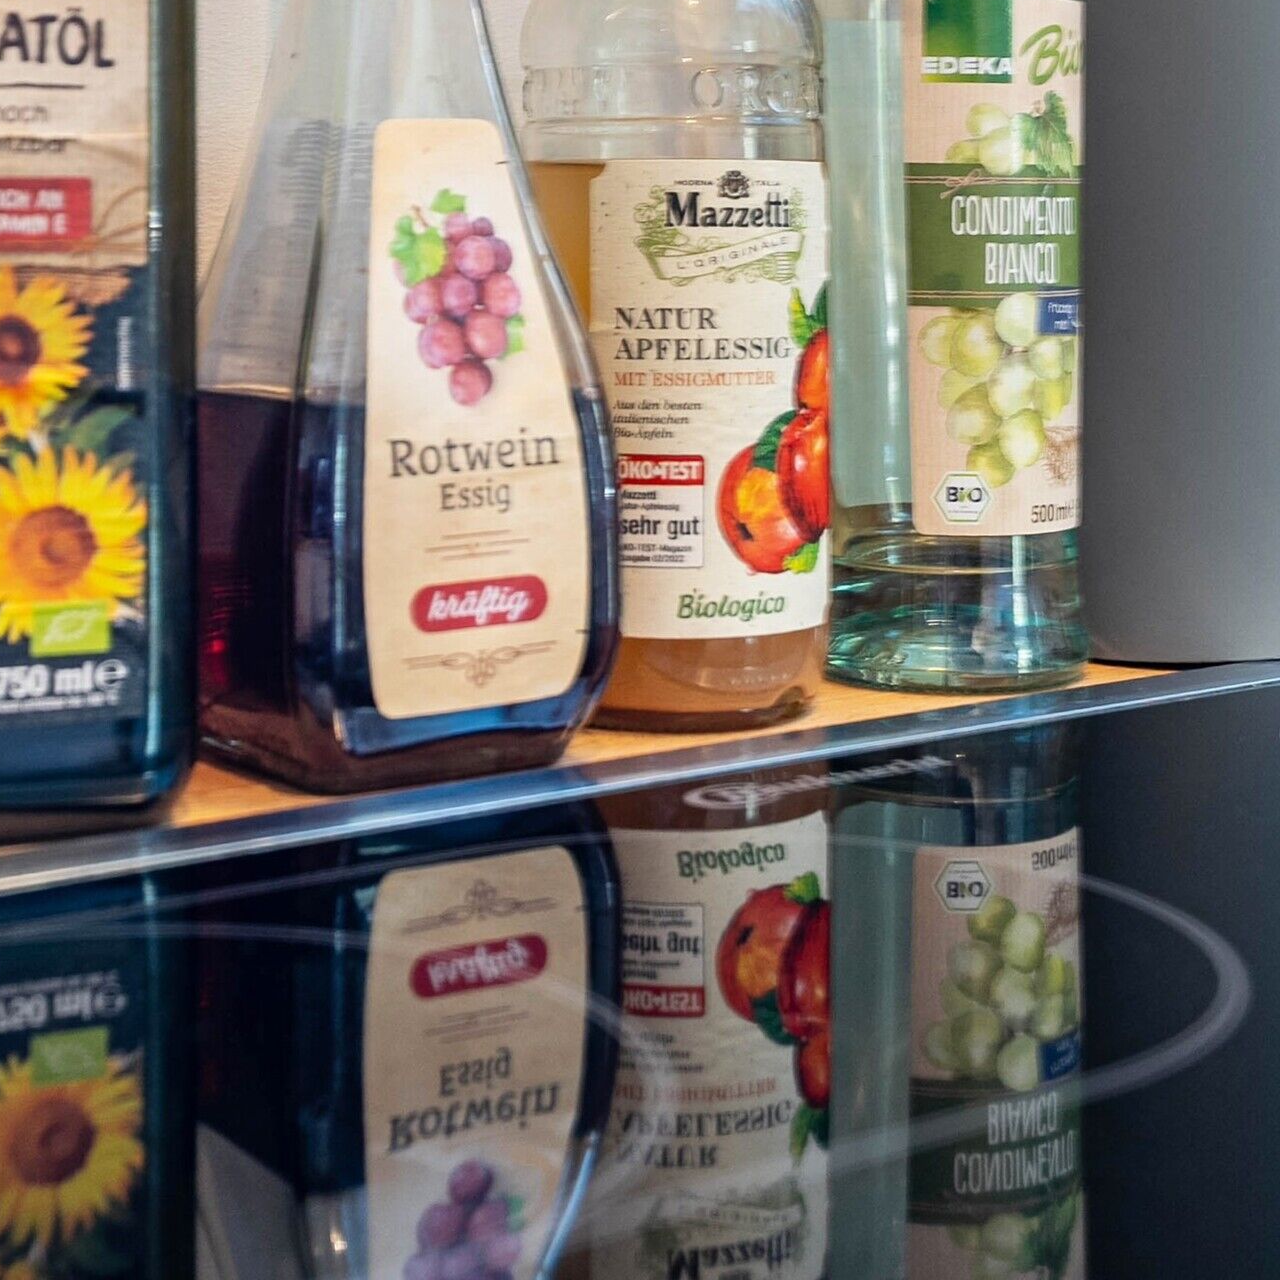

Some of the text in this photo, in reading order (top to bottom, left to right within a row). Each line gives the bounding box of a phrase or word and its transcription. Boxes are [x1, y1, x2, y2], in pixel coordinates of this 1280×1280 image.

[920, 56, 1013, 76] EDEKA
[663, 191, 790, 228] Mazzetti
[950, 196, 1077, 237] CONDIMENTO
[984, 243, 1060, 285] BIANCO
[613, 306, 719, 331] NATUR
[613, 336, 792, 361] APFELESSIG
[613, 371, 777, 388] MIT ESSIGMUTTER
[387, 427, 563, 478] Rotwein
[439, 478, 512, 514] Essig
[620, 514, 700, 540] sehr gut
[427, 584, 530, 627] kräftig
[677, 588, 786, 622] Biologico
[53, 660, 93, 695] ml
